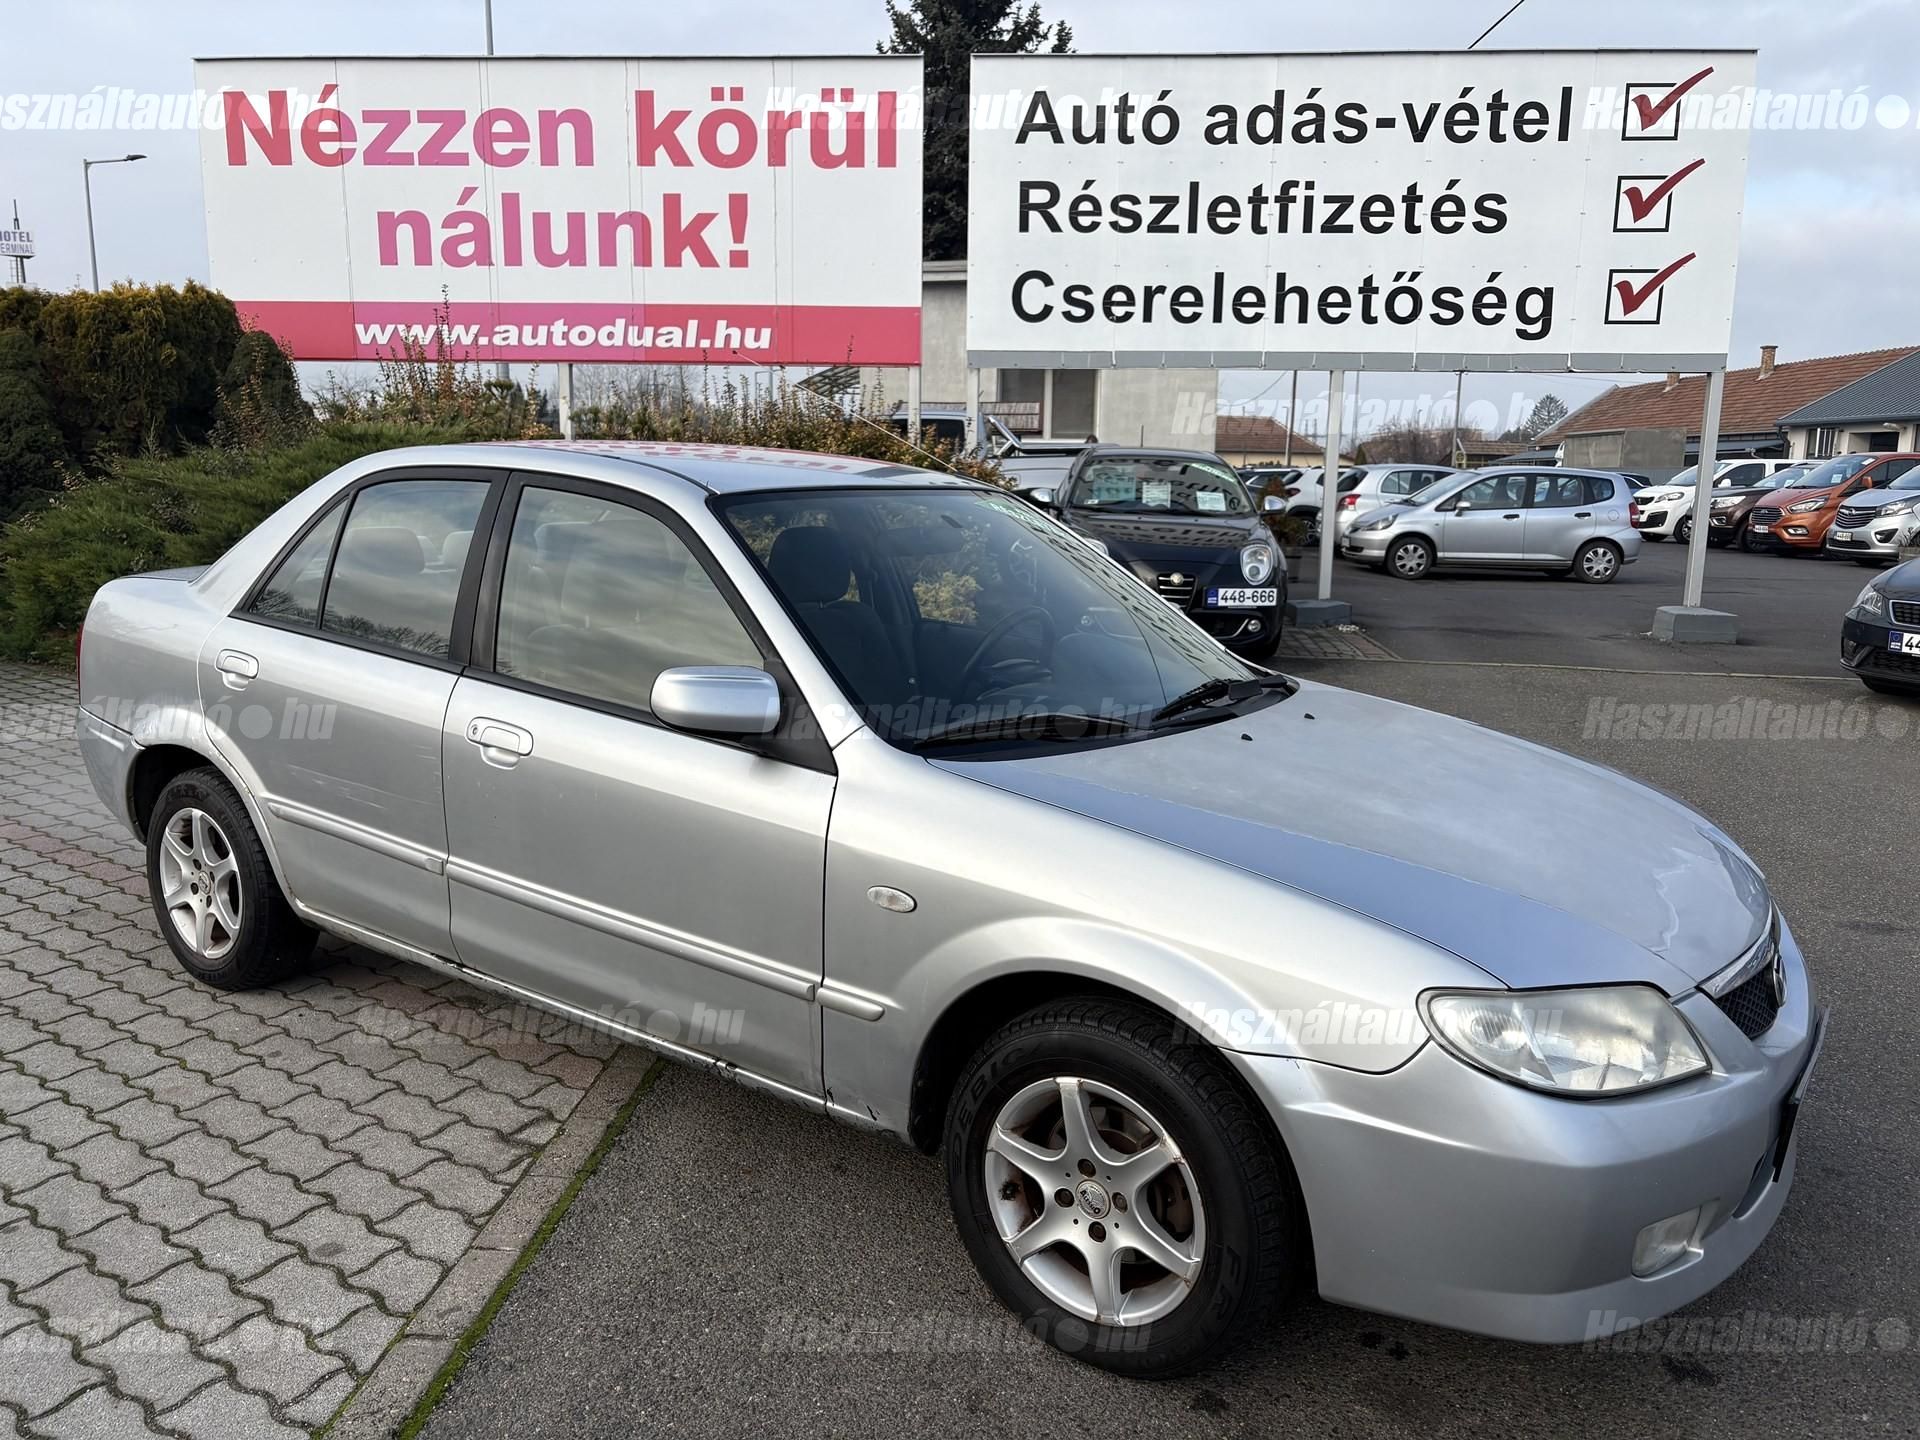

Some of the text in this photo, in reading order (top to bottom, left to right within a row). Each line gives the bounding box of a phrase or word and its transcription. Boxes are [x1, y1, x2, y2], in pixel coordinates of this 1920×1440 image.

[223, 83, 898, 169] Nézzen körül
[1015, 86, 1573, 146] Autó adás-vétel
[377, 187, 750, 269] nálunk!
[1018, 178, 1509, 235] Részletfizetés
[355, 318, 772, 350] www.autodual.hu
[1011, 270, 1555, 341] Cserelehetőség
[1220, 589, 1275, 604] 448-666
